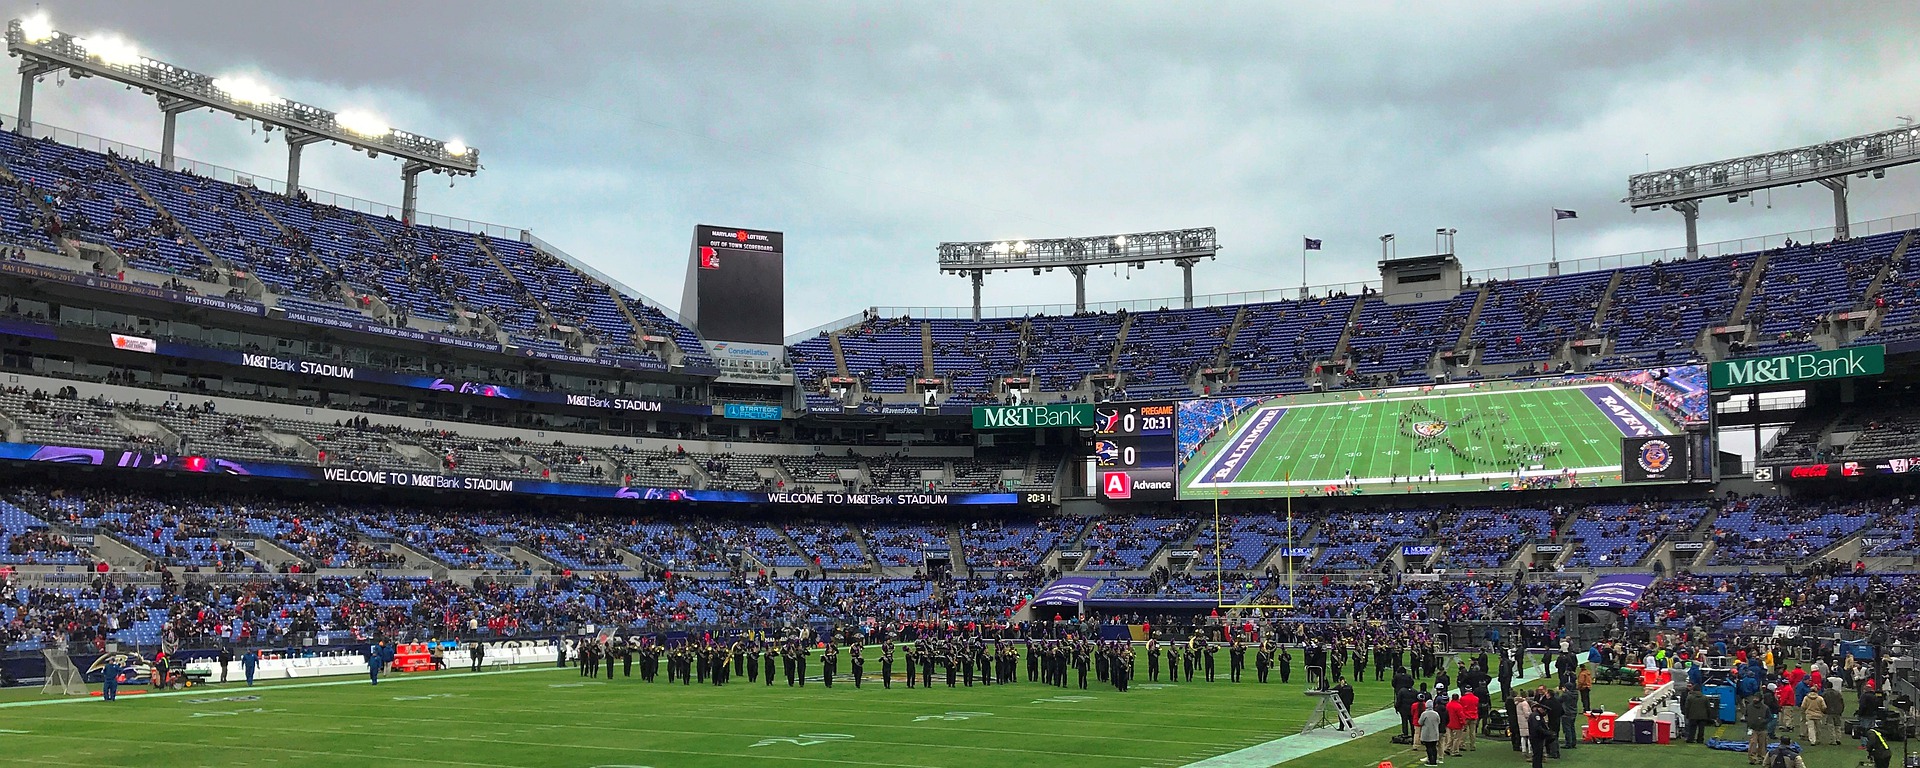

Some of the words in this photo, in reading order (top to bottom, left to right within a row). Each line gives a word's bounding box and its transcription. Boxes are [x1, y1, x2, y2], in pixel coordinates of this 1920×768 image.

[17, 267, 38, 276] LEWIS
[110, 283, 127, 291] REED
[186, 296, 202, 304] MATT
[202, 297, 226, 308] STOVER
[227, 300, 258, 313] 1996-2008
[288, 313, 306, 321] JAMAL
[307, 315, 323, 324] LEWIS
[324, 318, 352, 329] 2000-2006
[455, 339, 472, 347] BILLICK
[728, 348, 769, 356] Constellation
[569, 355, 597, 363] CHAMPIONS
[300, 362, 354, 379] STADIUM
[614, 399, 661, 412] STADIUM
[1141, 406, 1173, 416] PREGAME
[1124, 414, 1135, 432] 0
[1142, 416, 1171, 430] 20:31
[1124, 446, 1135, 465] 0
[323, 468, 386, 484] WELCOME
[390, 473, 407, 485] TO
[464, 478, 512, 492] STADIUM
[1756, 469, 1770, 479] 25
[1108, 475, 1123, 492] A
[1133, 480, 1171, 489] Advance
[768, 493, 823, 503] WELCOME
[827, 494, 843, 504] TO
[898, 495, 947, 505] STADIUM
[1027, 494, 1050, 503] 20:31
[1598, 719, 1610, 732] G
